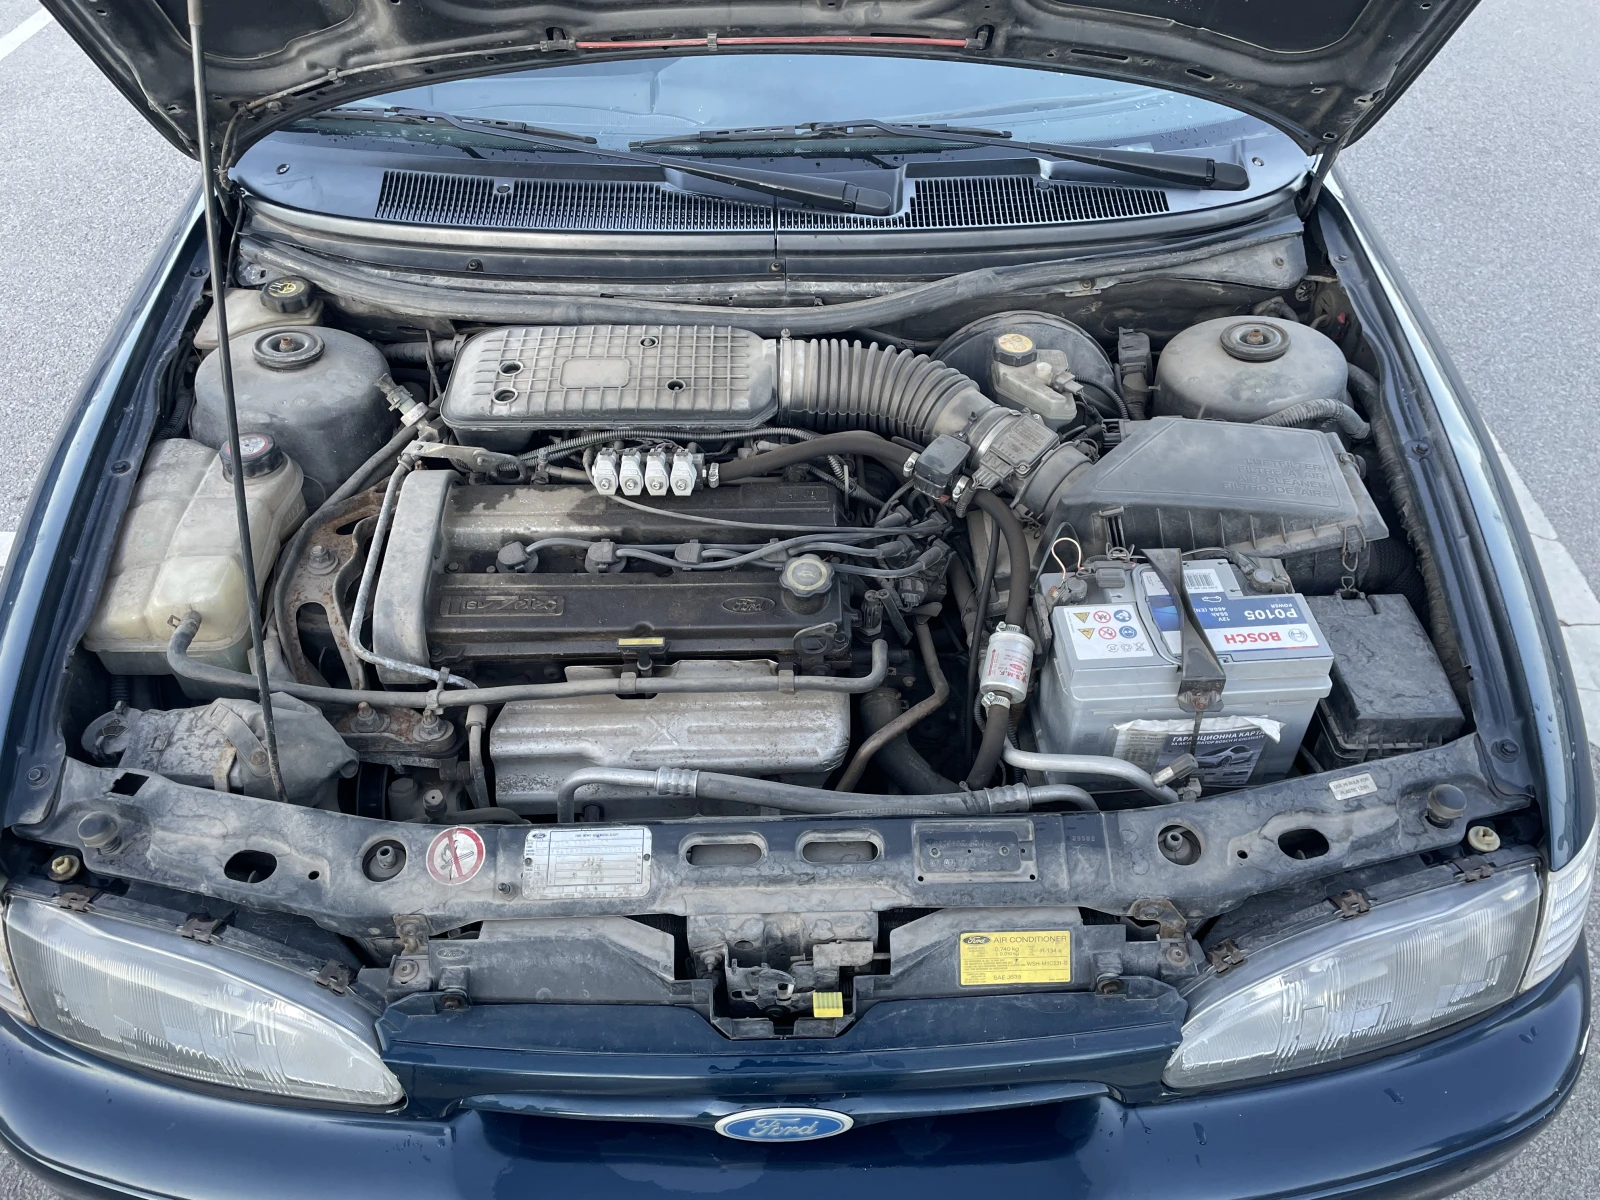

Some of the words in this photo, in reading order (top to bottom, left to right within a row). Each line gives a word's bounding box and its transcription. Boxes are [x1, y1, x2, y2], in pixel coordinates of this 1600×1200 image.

[1236, 465, 1282, 476] FILTRE
[1303, 471, 1326, 480] AIR
[1237, 474, 1259, 483] AIR
[1265, 476, 1328, 489] CLEANER
[1222, 481, 1270, 492] FILTRO
[1275, 486, 1296, 495] DE
[1301, 488, 1332, 498] AIRE
[1244, 608, 1298, 620] P0105
[1223, 631, 1282, 644] BOSCH
[1172, 733, 1237, 742] ГАРАЦИОННА
[1239, 730, 1266, 738] КАРТА
[1009, 935, 1067, 944] CONDITIONER
[749, 1117, 820, 1138] Ford
